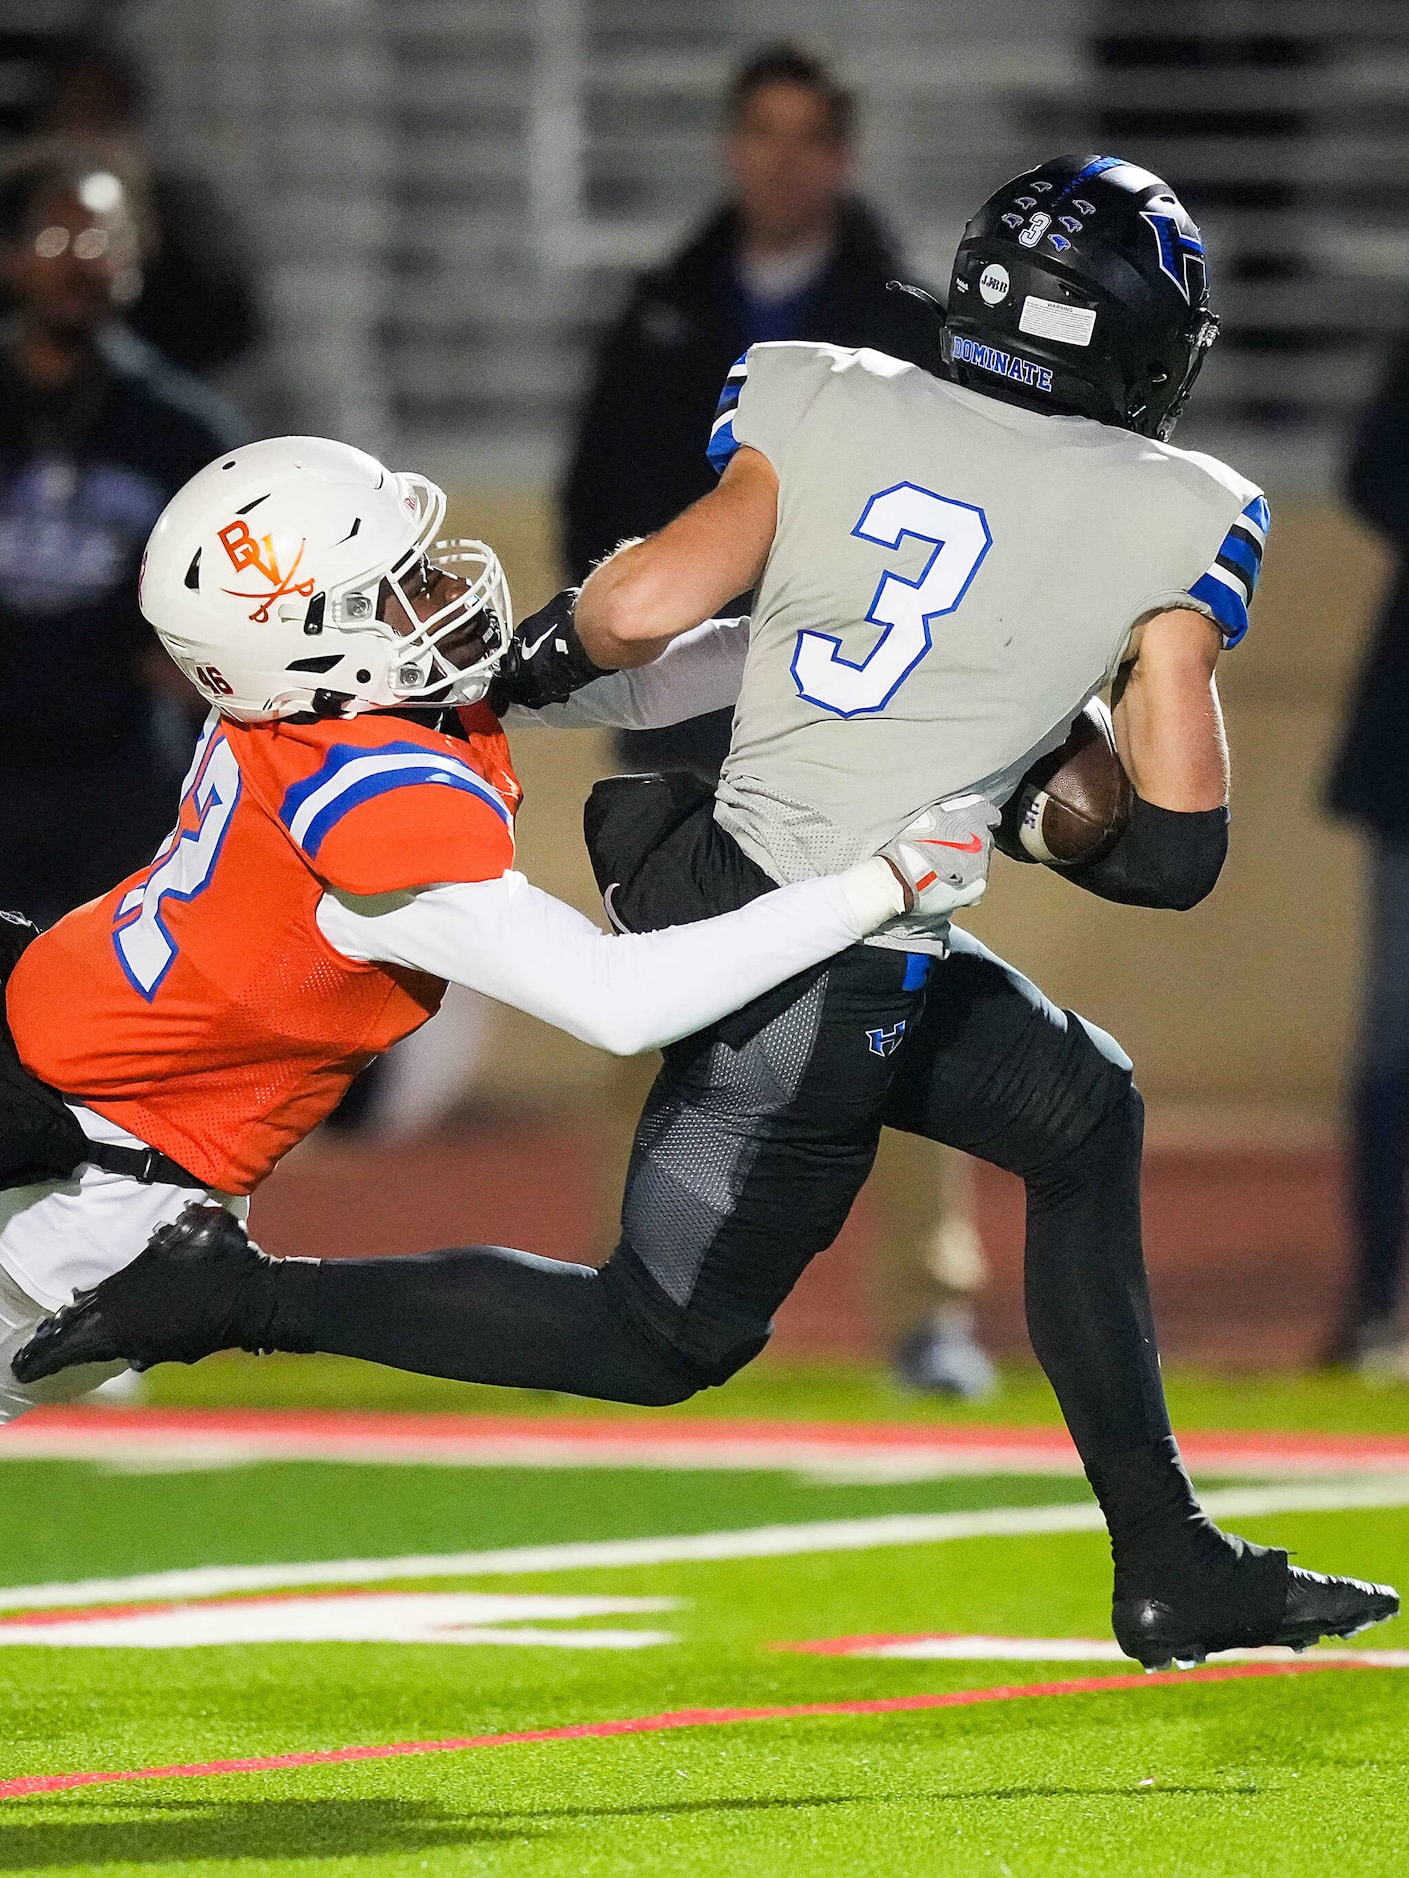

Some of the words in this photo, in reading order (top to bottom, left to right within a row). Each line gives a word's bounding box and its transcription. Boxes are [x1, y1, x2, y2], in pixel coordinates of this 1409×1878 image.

[1018, 211, 1053, 249] 3
[1047, 303, 1074, 314] WARNING
[952, 335, 1054, 392] DOMINATE
[217, 520, 283, 586] BV
[789, 480, 994, 720] 3
[195, 666, 234, 696] 46
